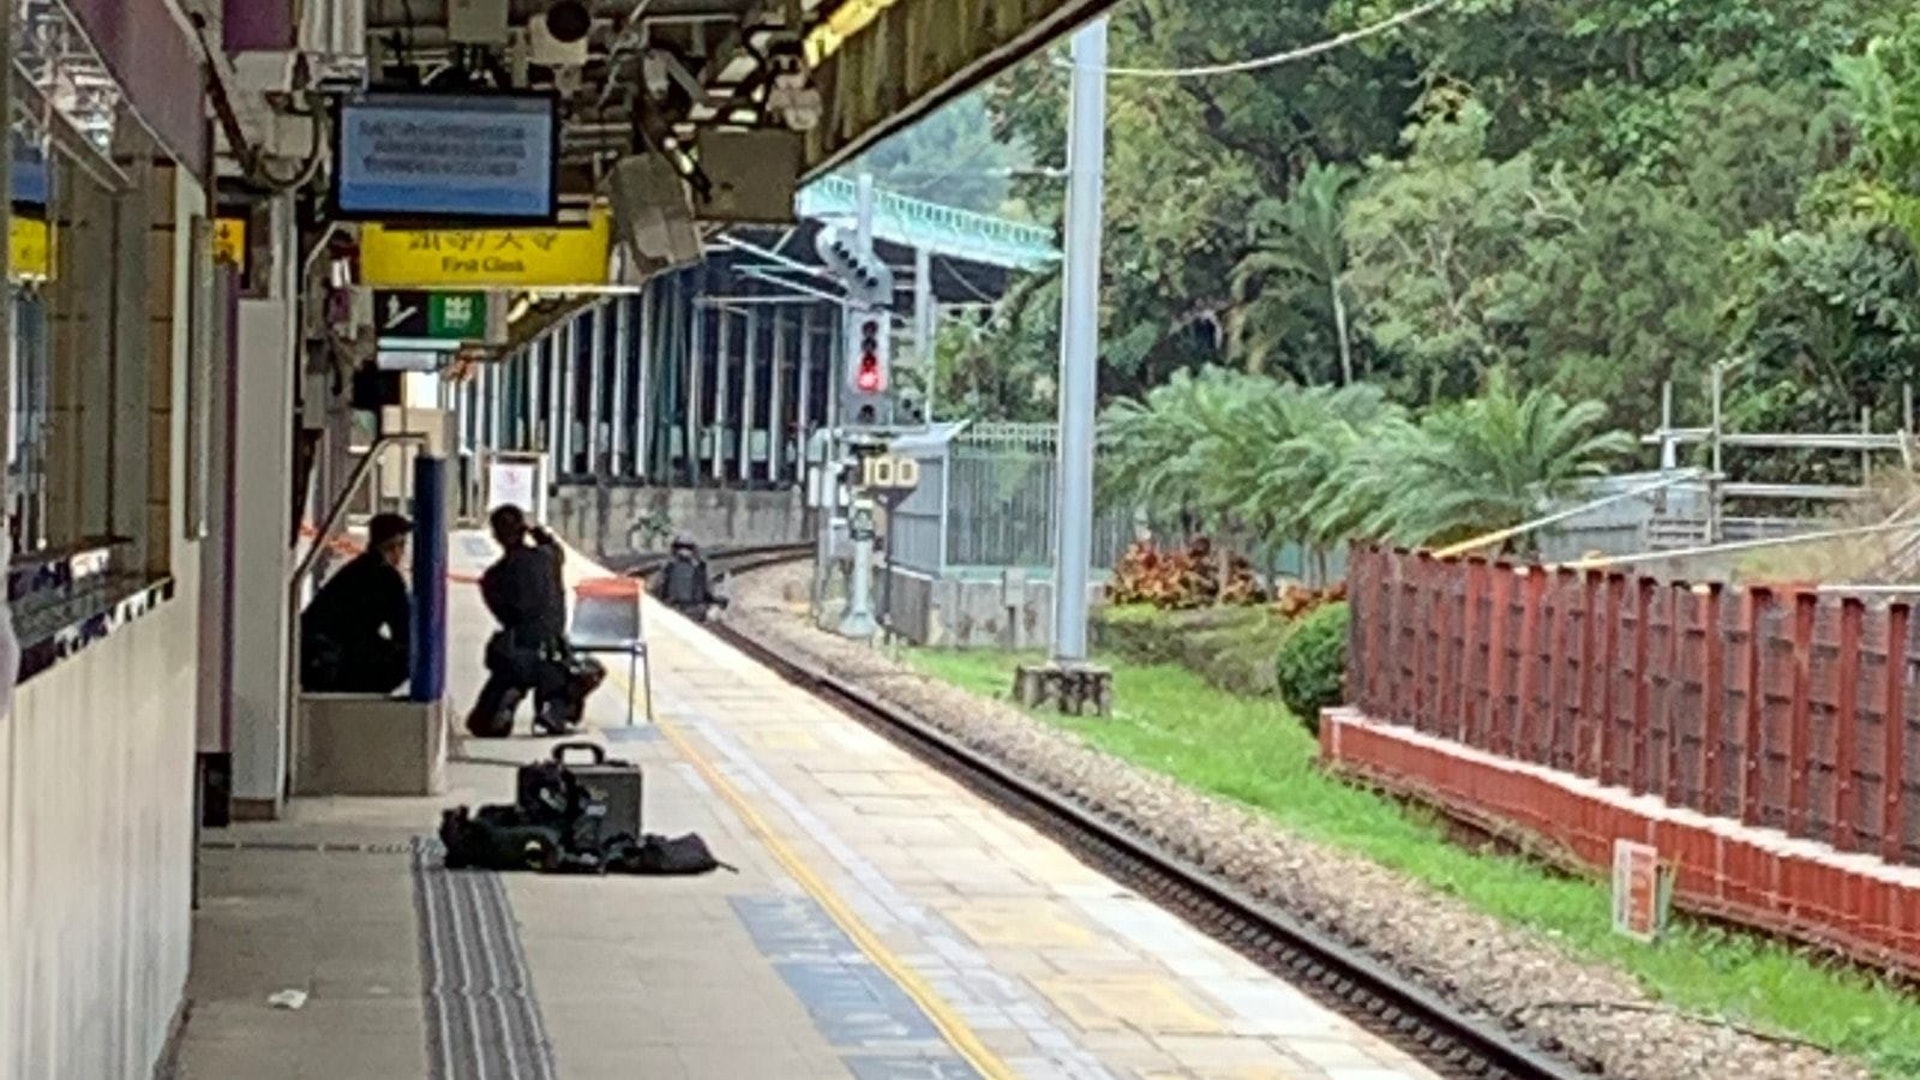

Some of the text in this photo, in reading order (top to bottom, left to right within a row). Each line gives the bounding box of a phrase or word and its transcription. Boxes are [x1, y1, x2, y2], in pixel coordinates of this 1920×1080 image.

[442, 257, 525, 272] First Class
[864, 457, 919, 487] 100
